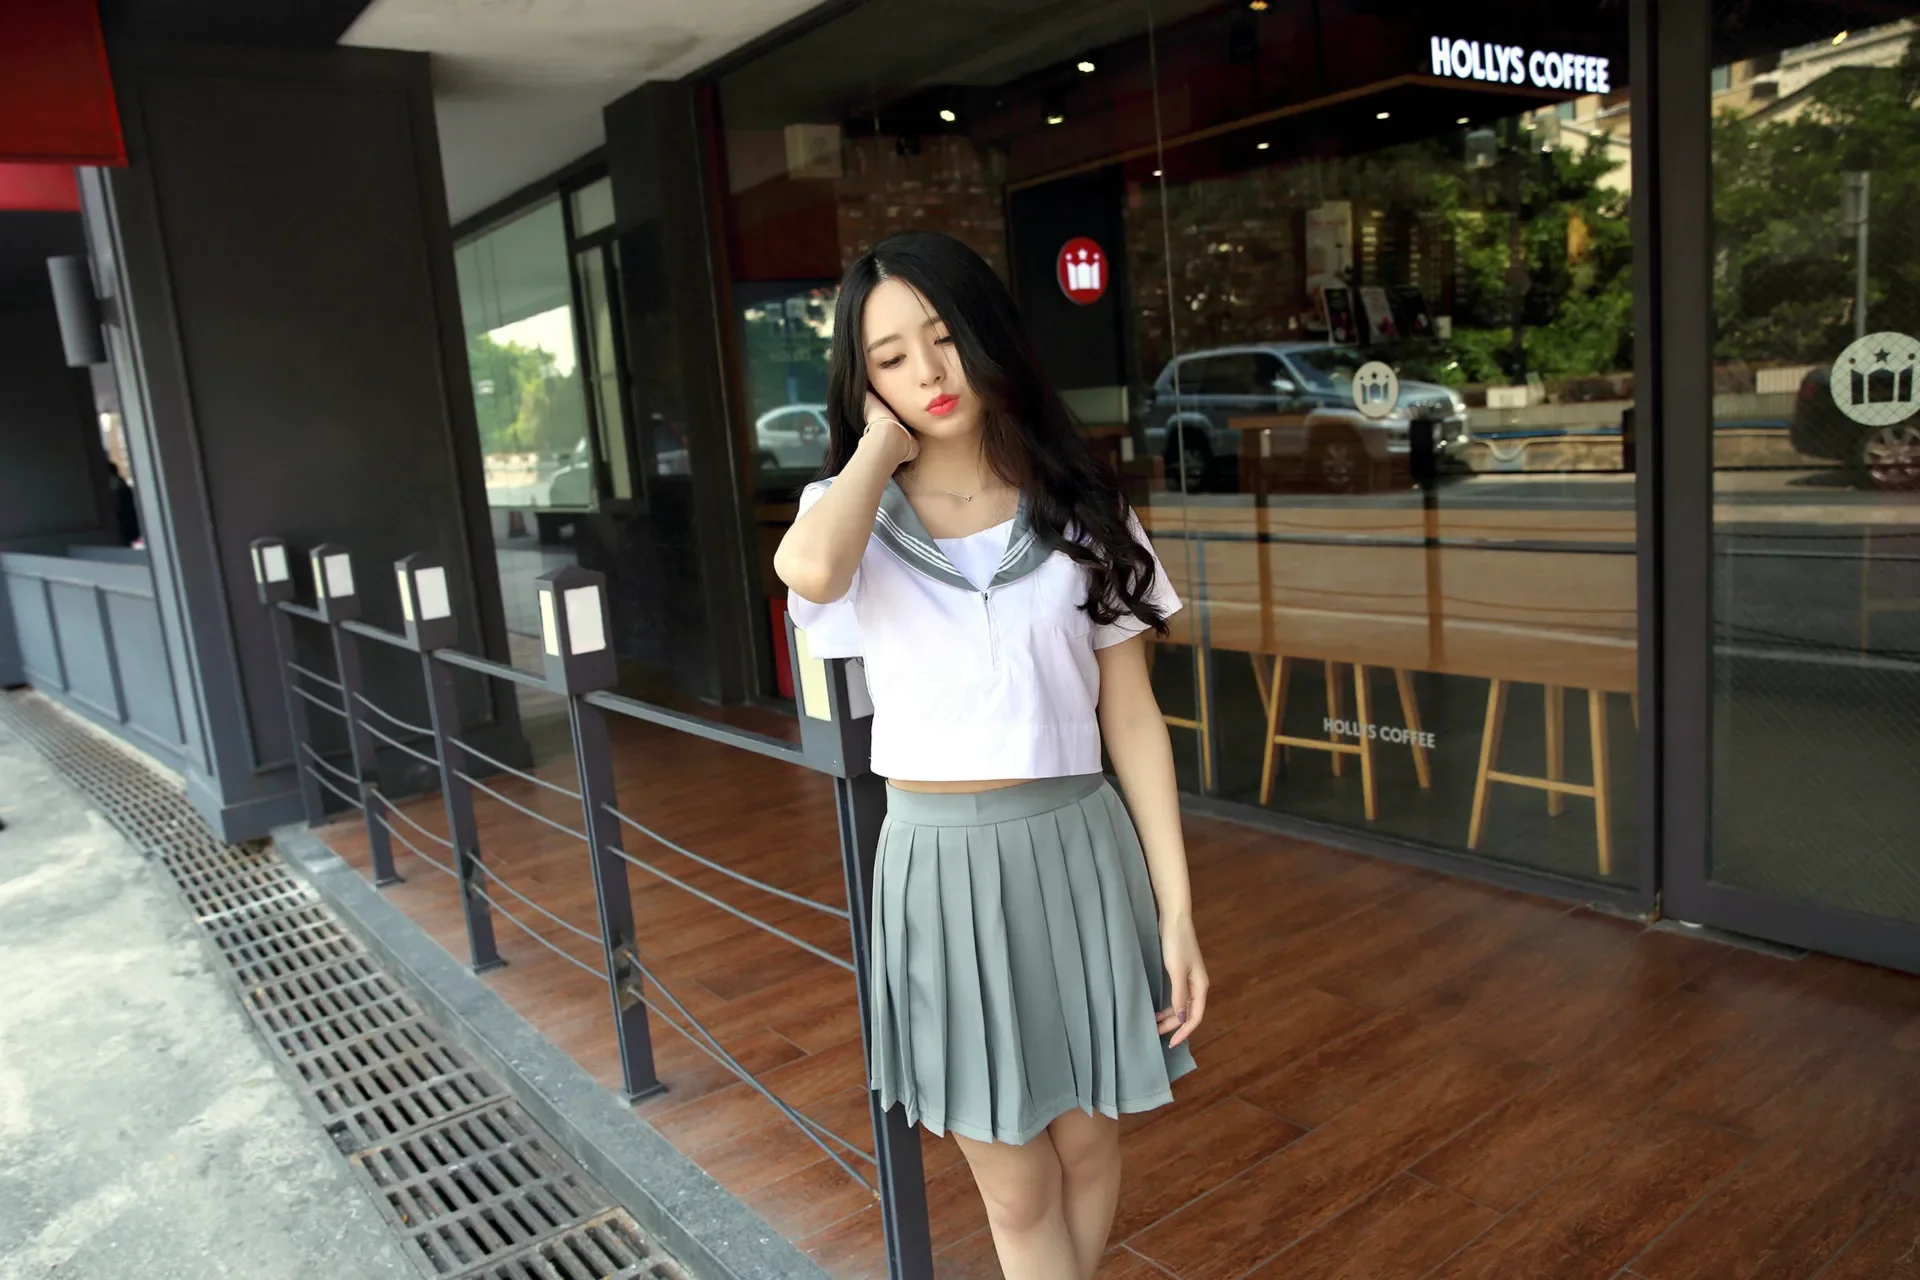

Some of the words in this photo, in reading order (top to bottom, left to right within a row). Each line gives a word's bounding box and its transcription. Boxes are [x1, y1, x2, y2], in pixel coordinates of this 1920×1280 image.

[1430, 36, 1525, 84] HOLLYS
[1528, 50, 1610, 93] COFFEE
[1323, 717, 1377, 739] HOLLYS
[1379, 726, 1436, 749] COFFEE
